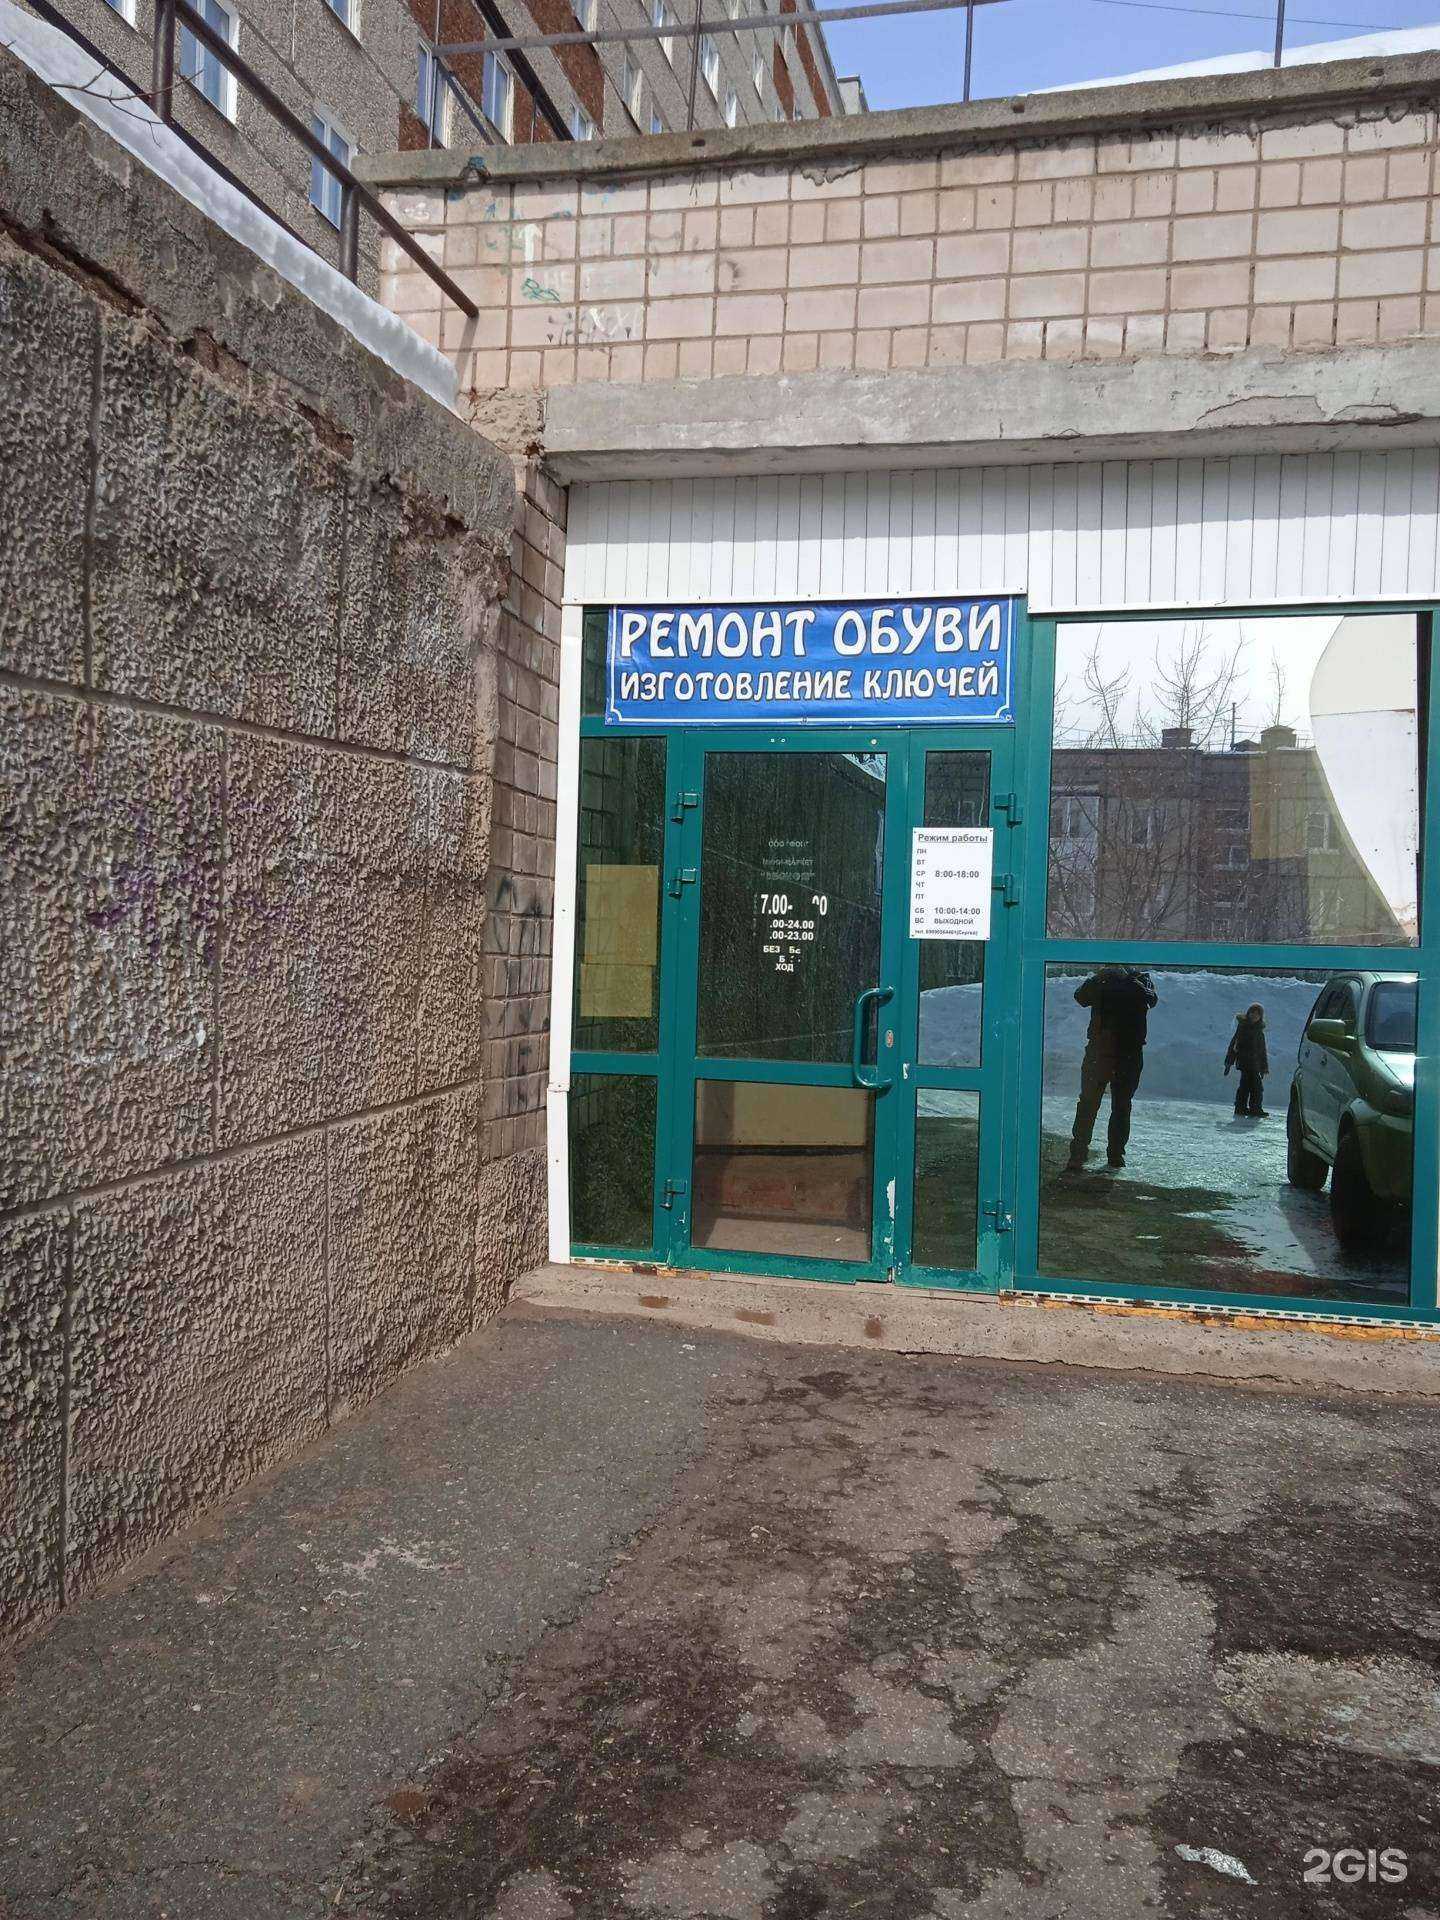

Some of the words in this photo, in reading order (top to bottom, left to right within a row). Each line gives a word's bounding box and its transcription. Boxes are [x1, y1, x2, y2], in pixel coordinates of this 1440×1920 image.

[620, 609, 816, 658] РЕМОНТ
[833, 603, 1001, 656] ОБУВИ
[620, 670, 852, 701] ИЗГОТОВЛЕНИЕ
[863, 659, 999, 700] КЛЮЧЕЙ
[918, 834, 949, 842] Режим
[952, 834, 988, 843] работы
[934, 870, 980, 879] 8:00-18:00
[934, 907, 981, 915] 10:00-14:00
